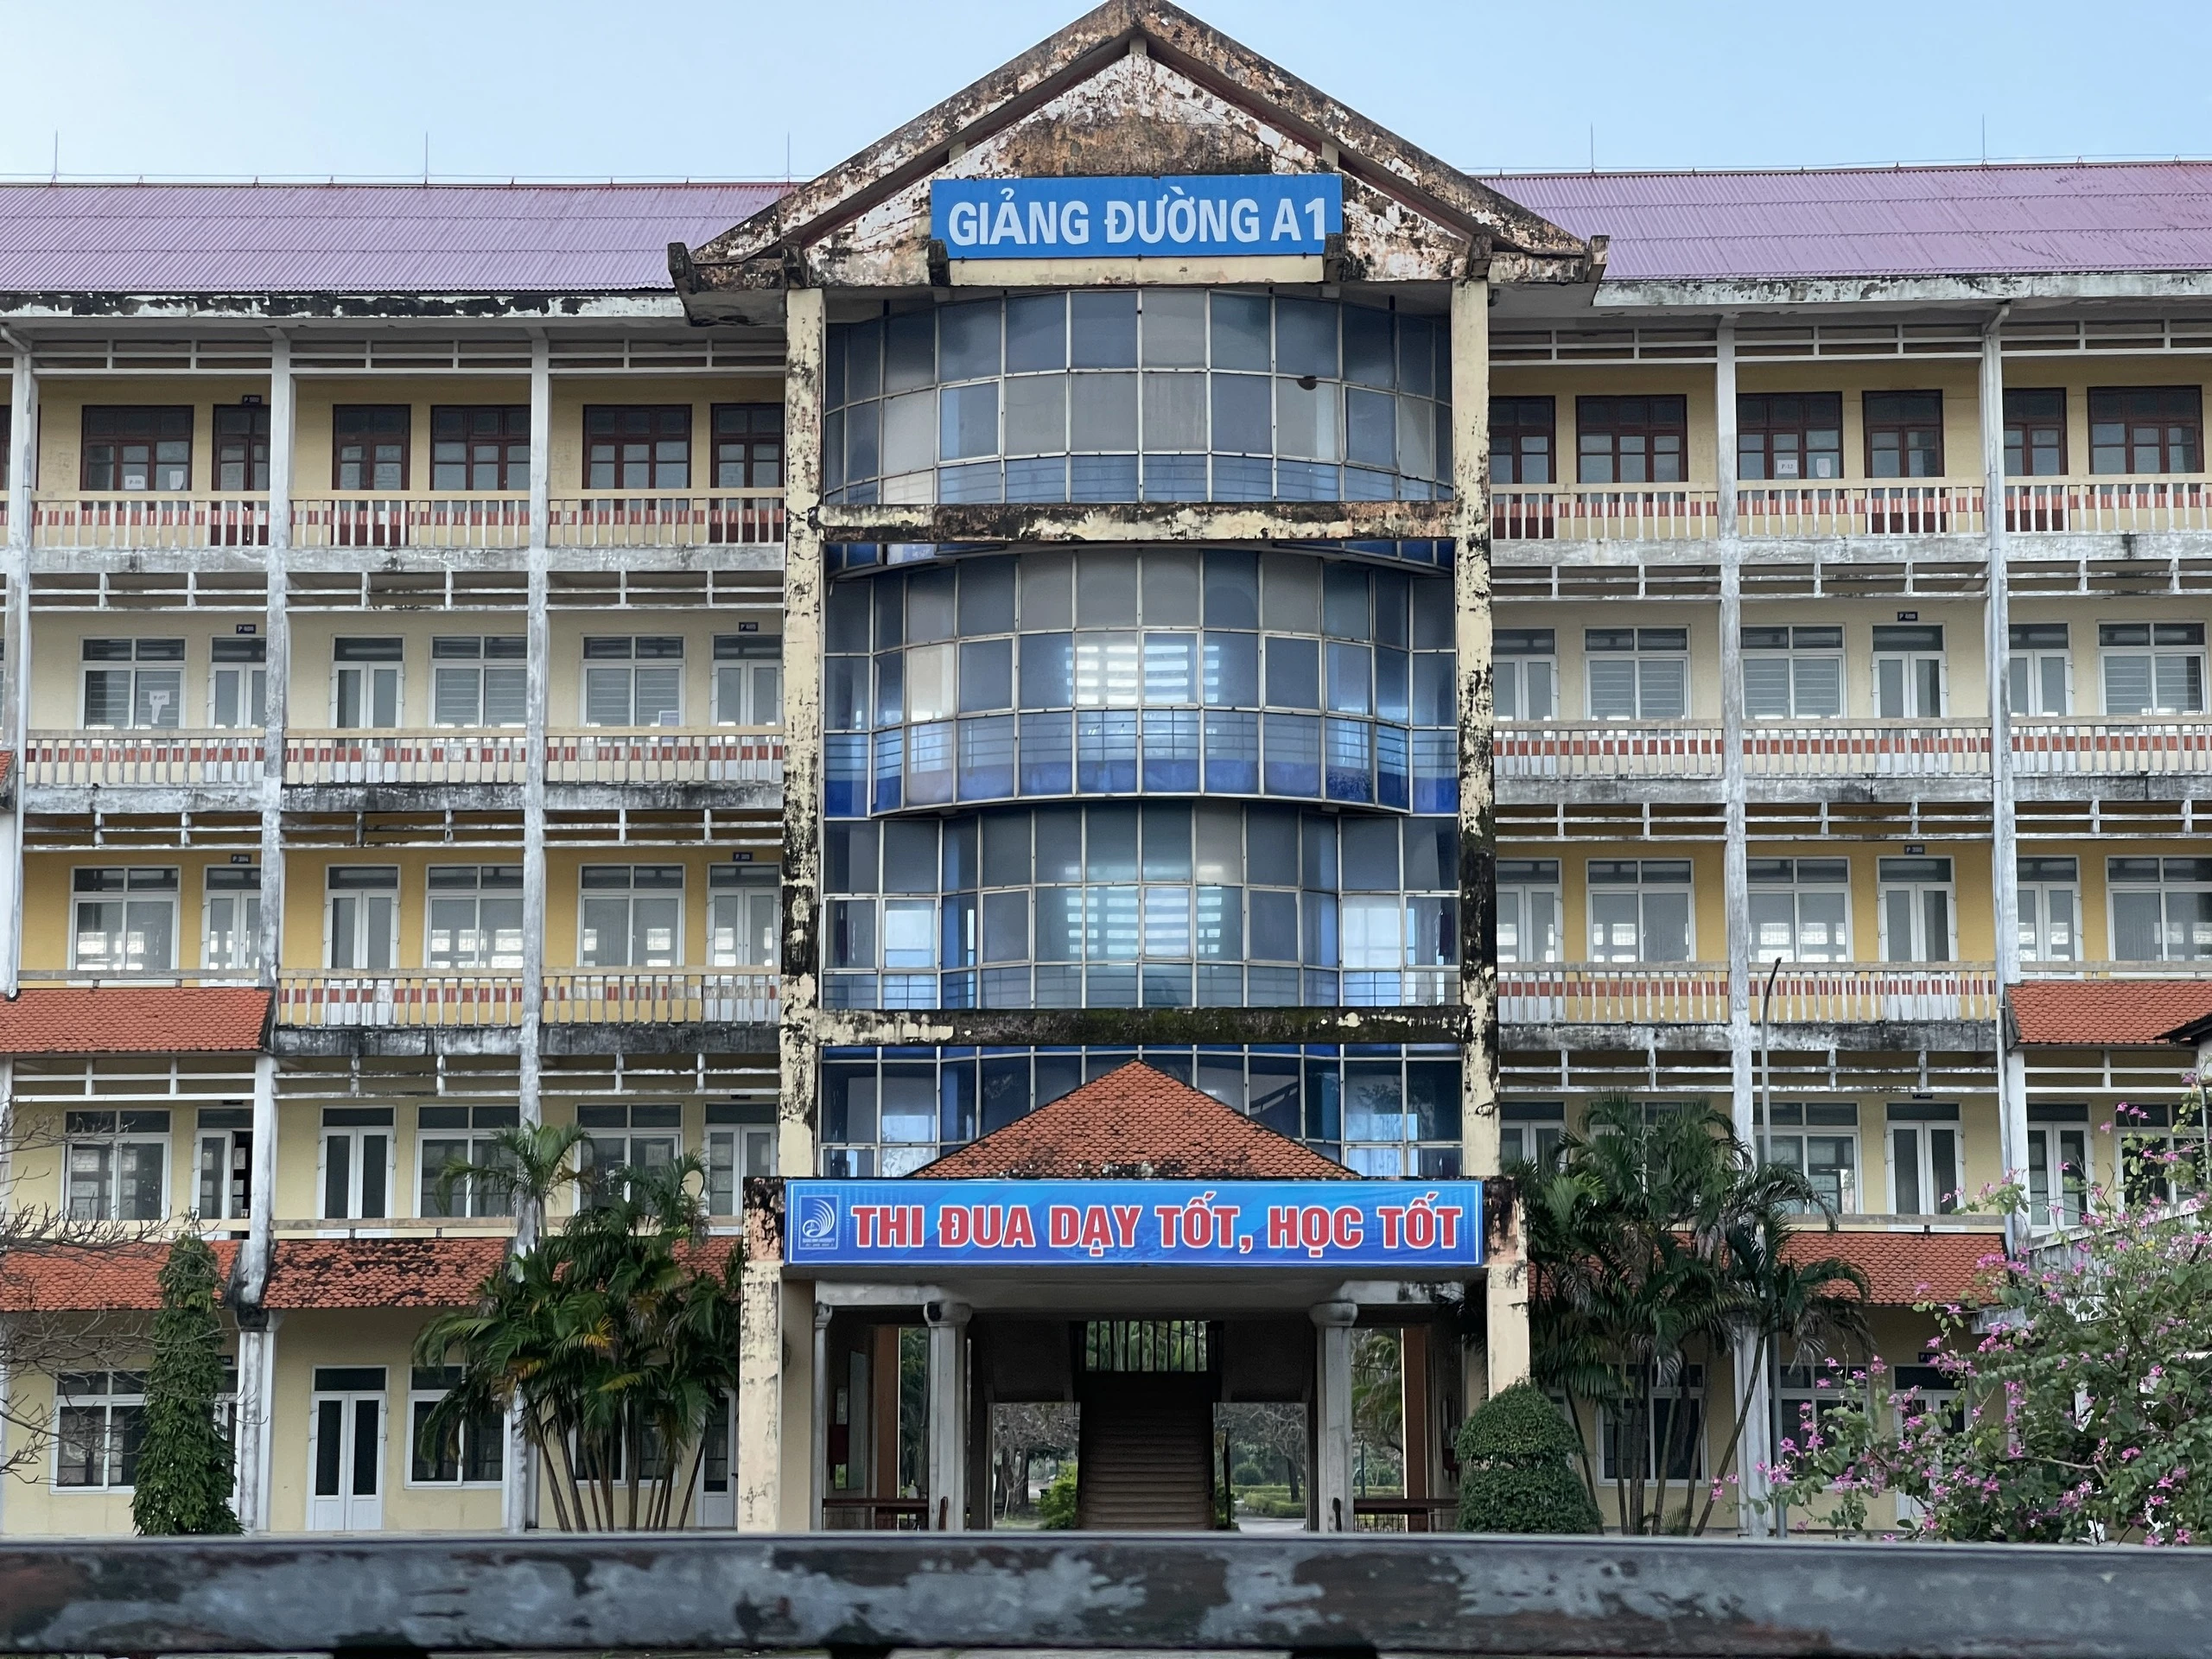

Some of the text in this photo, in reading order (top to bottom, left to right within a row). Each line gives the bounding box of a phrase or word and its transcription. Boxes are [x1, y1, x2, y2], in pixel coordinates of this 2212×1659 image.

[950, 186, 1326, 245] GIẢNG ĐƯỜNG A1
[851, 1191, 1463, 1258] THI ĐUA DẠY TỐT, HỌC TỐT
